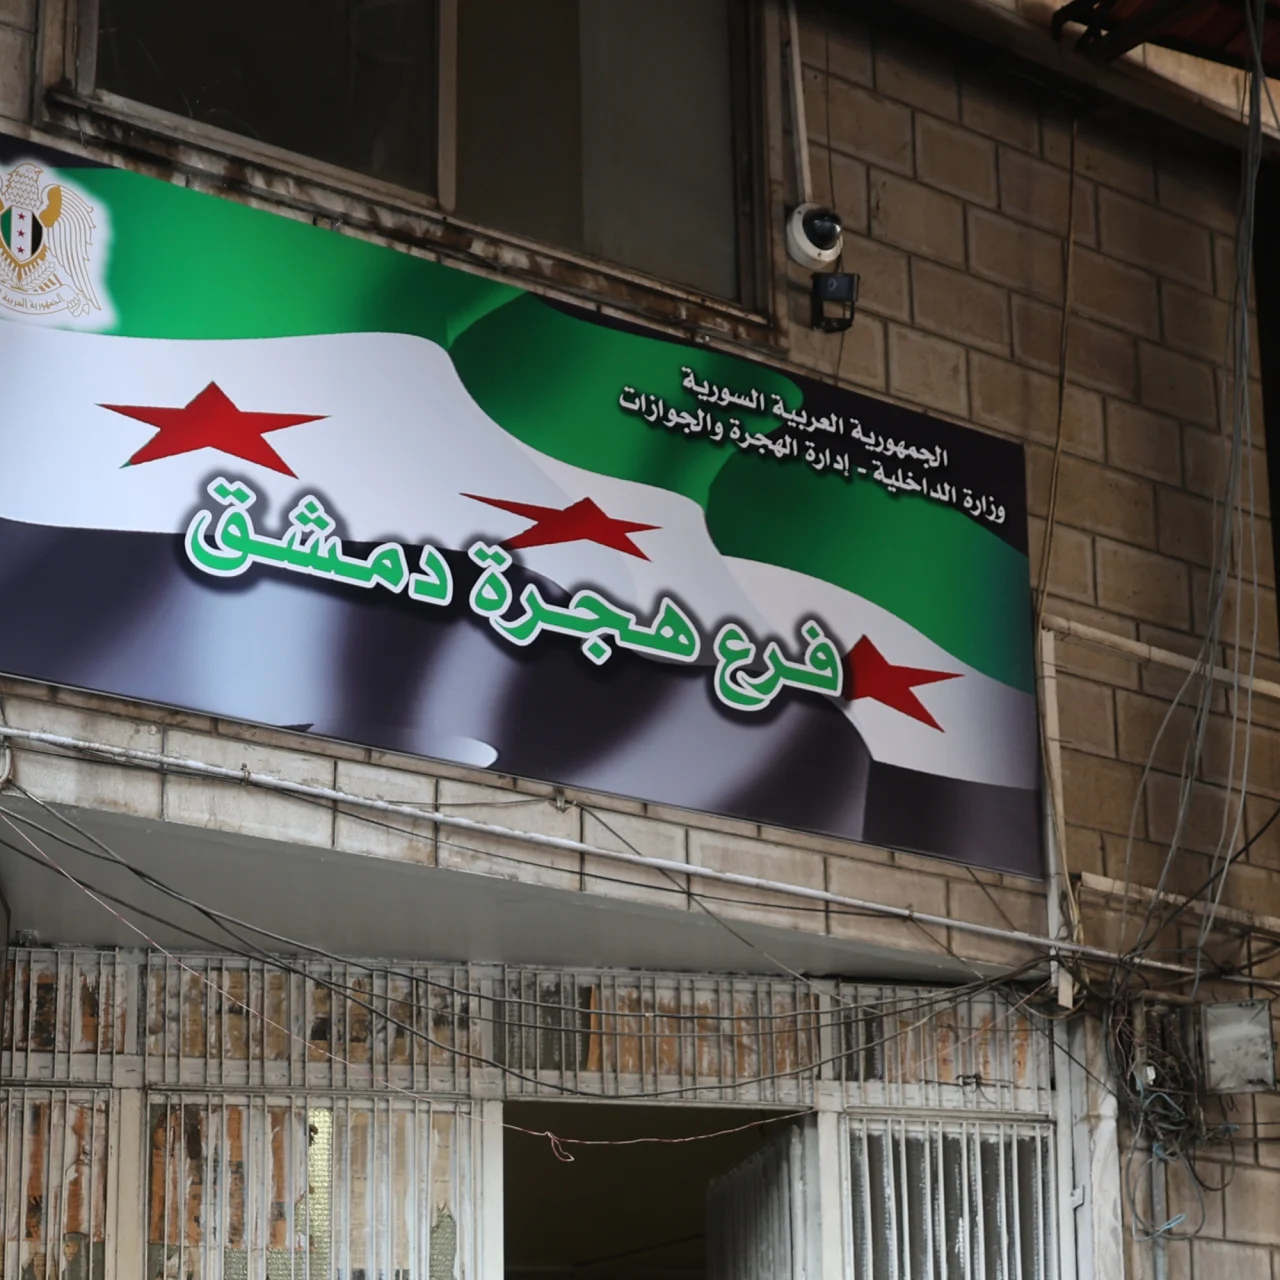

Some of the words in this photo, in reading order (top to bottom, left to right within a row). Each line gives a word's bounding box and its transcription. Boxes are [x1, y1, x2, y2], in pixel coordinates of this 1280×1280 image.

[681, 366, 765, 411] السورية
[619, 386, 724, 441] والجوازات
[772, 393, 844, 434] العربية
[729, 416, 798, 459] الهجرة
[805, 440, 850, 477] إدارة
[849, 416, 949, 468] الجمهورية
[872, 460, 956, 503] الداخلية
[963, 488, 1006, 524] وزارة
[184, 476, 453, 606] دمشق
[468, 540, 702, 665] هجرة
[714, 619, 844, 711] فرع
